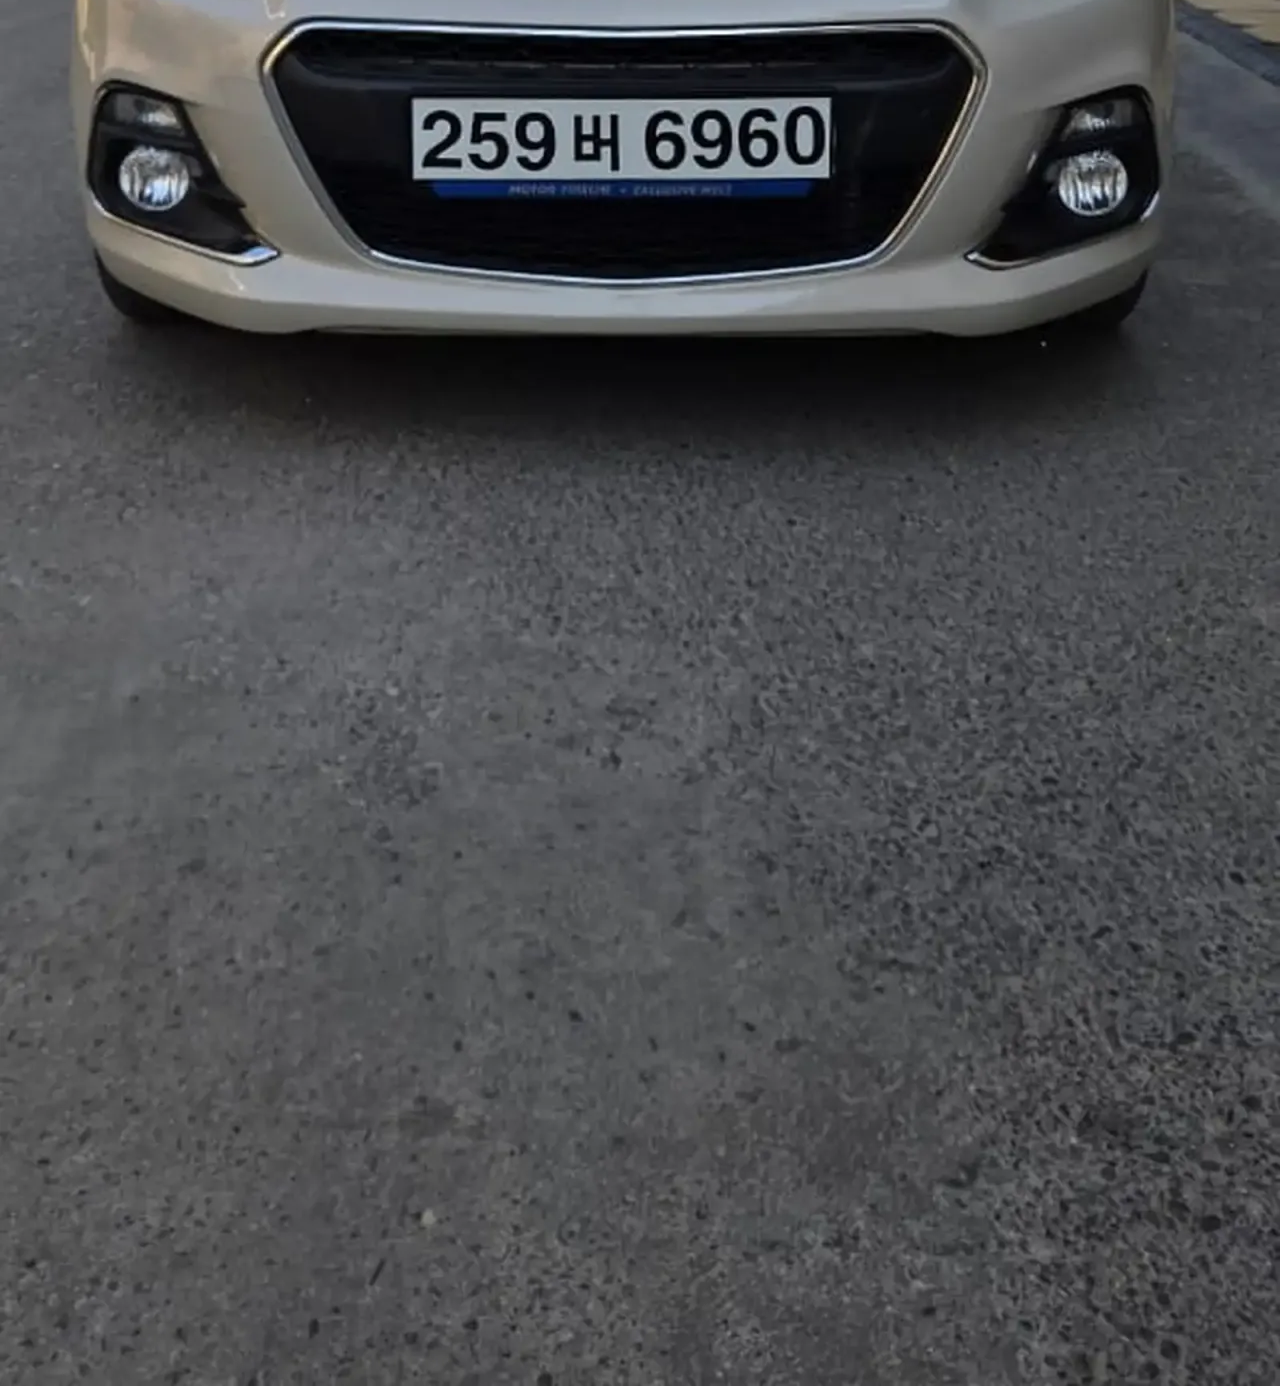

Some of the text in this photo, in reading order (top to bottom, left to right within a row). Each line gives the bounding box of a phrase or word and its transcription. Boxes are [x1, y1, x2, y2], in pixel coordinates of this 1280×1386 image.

[421, 105, 826, 172] 259 버 6960
